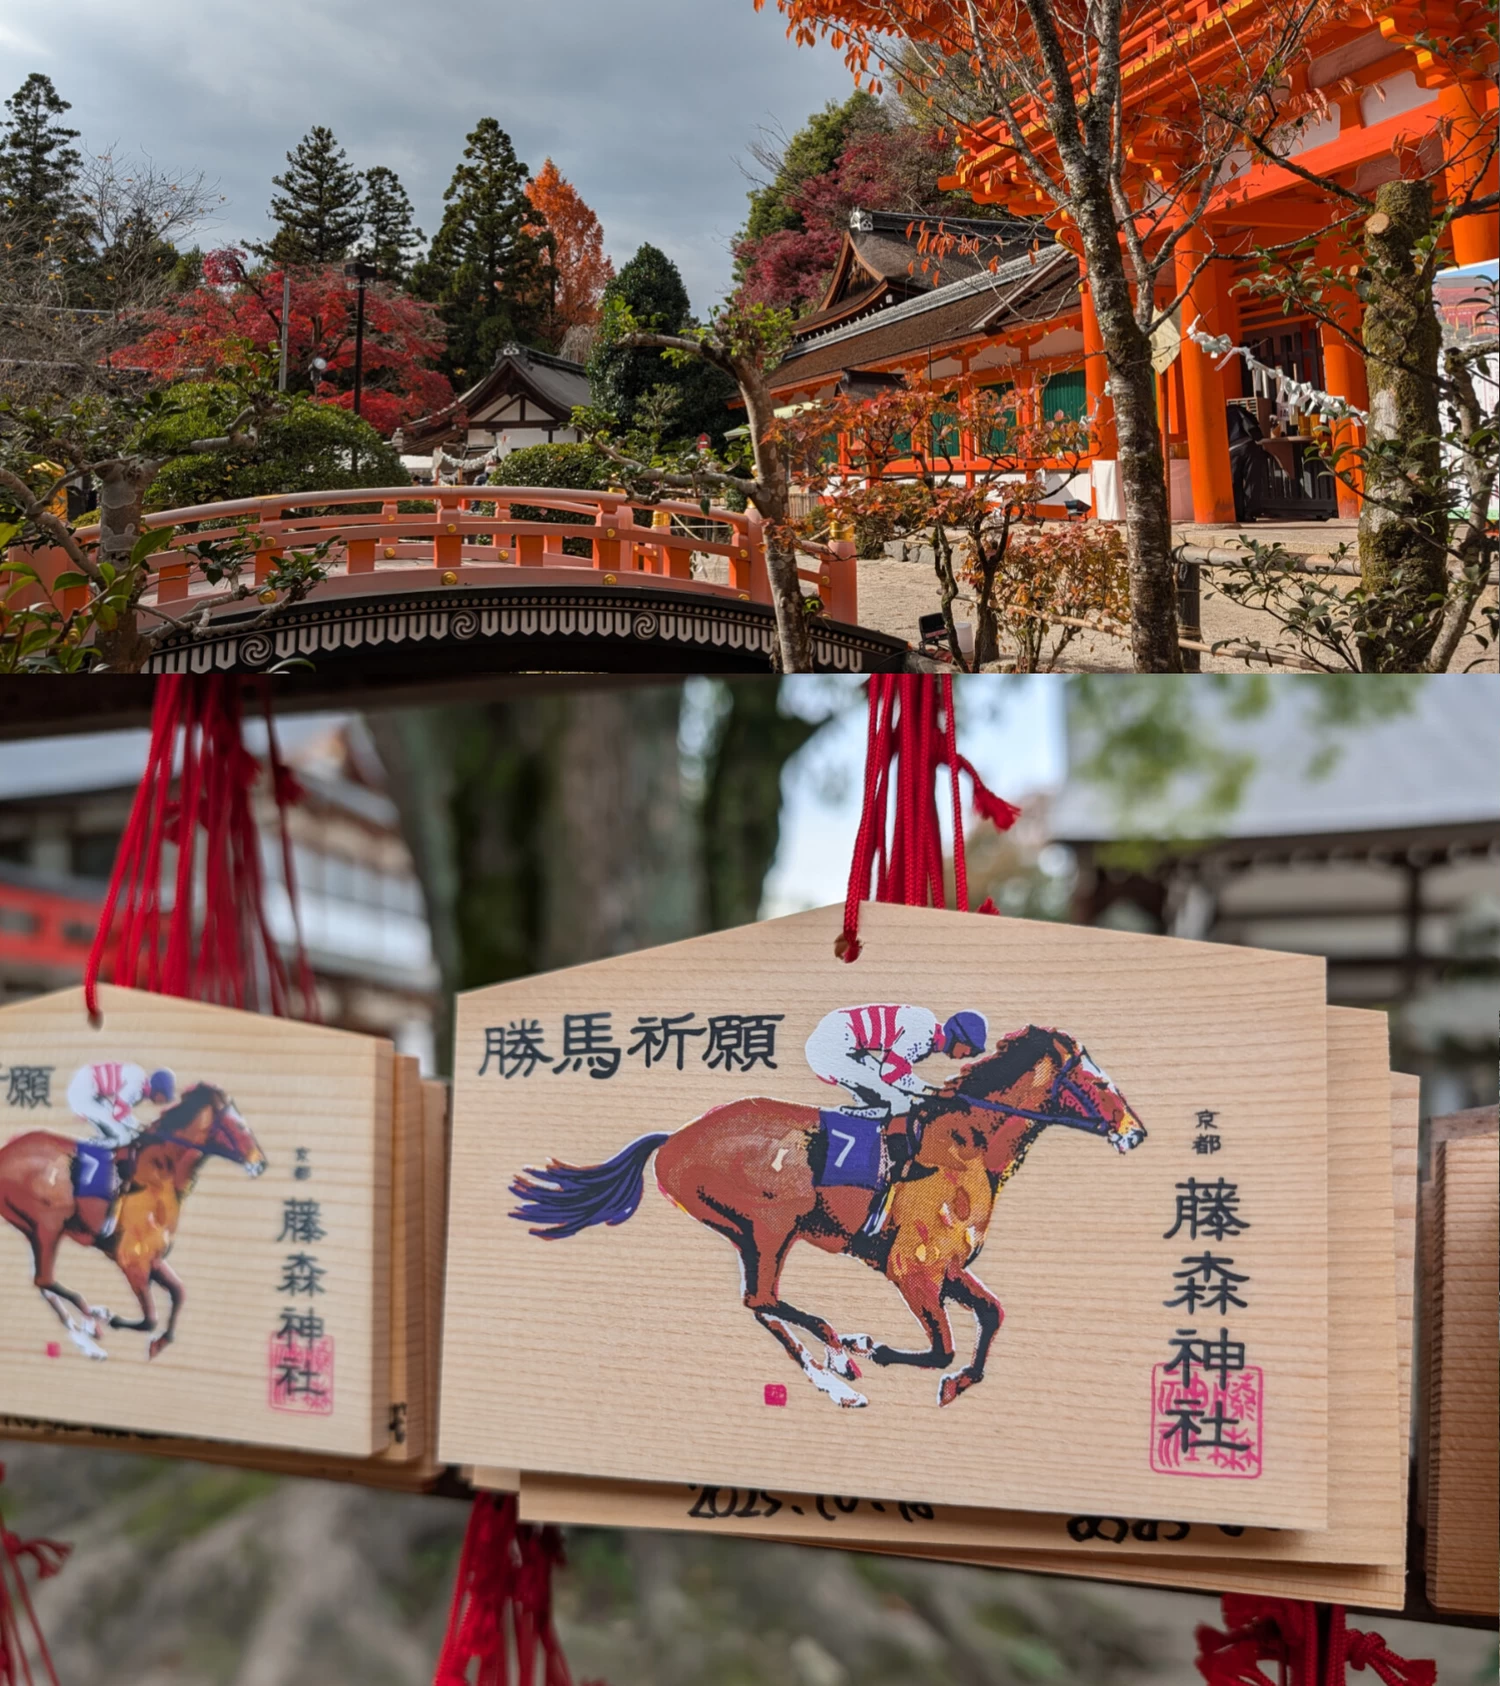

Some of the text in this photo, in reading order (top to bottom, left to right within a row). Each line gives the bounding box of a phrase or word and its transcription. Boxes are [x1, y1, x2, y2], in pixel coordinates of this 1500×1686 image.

[478, 1011, 785, 1079] 勝馬祈願
[0, 1064, 57, 1109] 願
[831, 1129, 856, 1168] 7
[277, 1197, 327, 1396] 藤森神社
[1163, 1109, 1250, 1453] 京都 藤森神社
